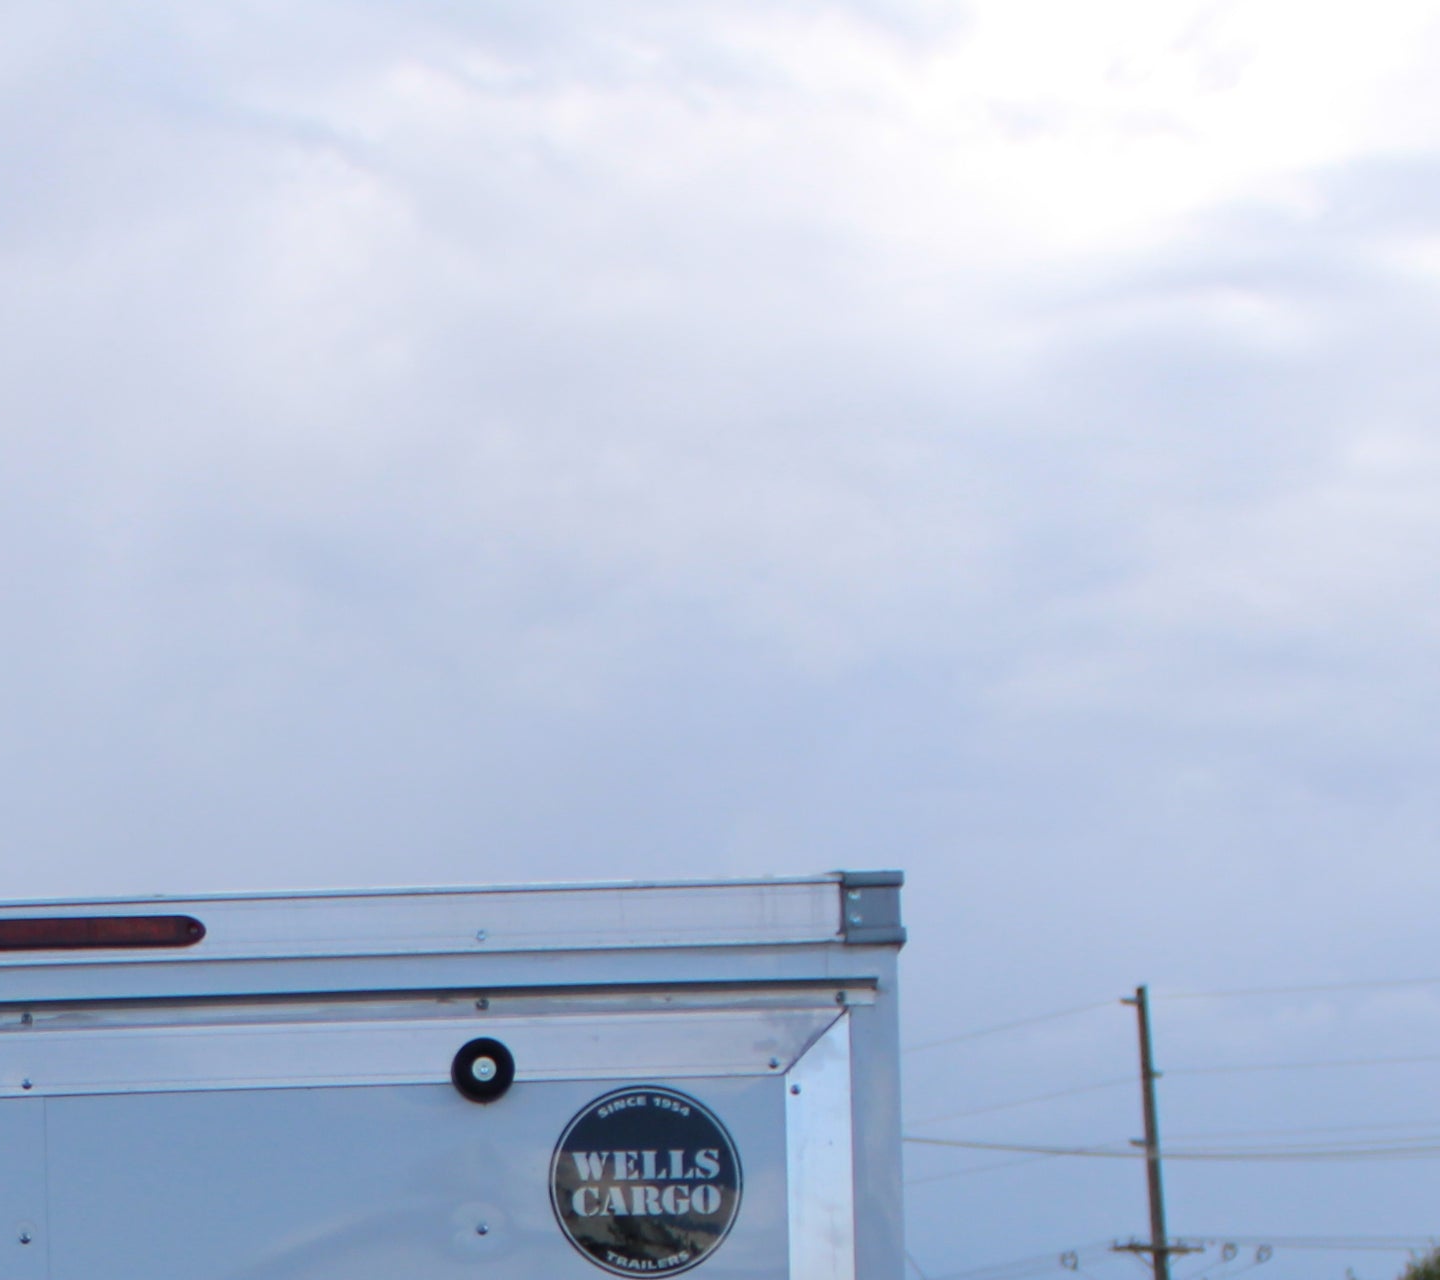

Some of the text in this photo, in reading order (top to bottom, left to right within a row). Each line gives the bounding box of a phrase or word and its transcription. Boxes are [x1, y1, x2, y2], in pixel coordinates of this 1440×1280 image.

[597, 1095, 691, 1119] SINCE 1954
[572, 1149, 720, 1181] WELLS
[572, 1184, 721, 1217] CARGO
[606, 1250, 691, 1270] TRAILERS
